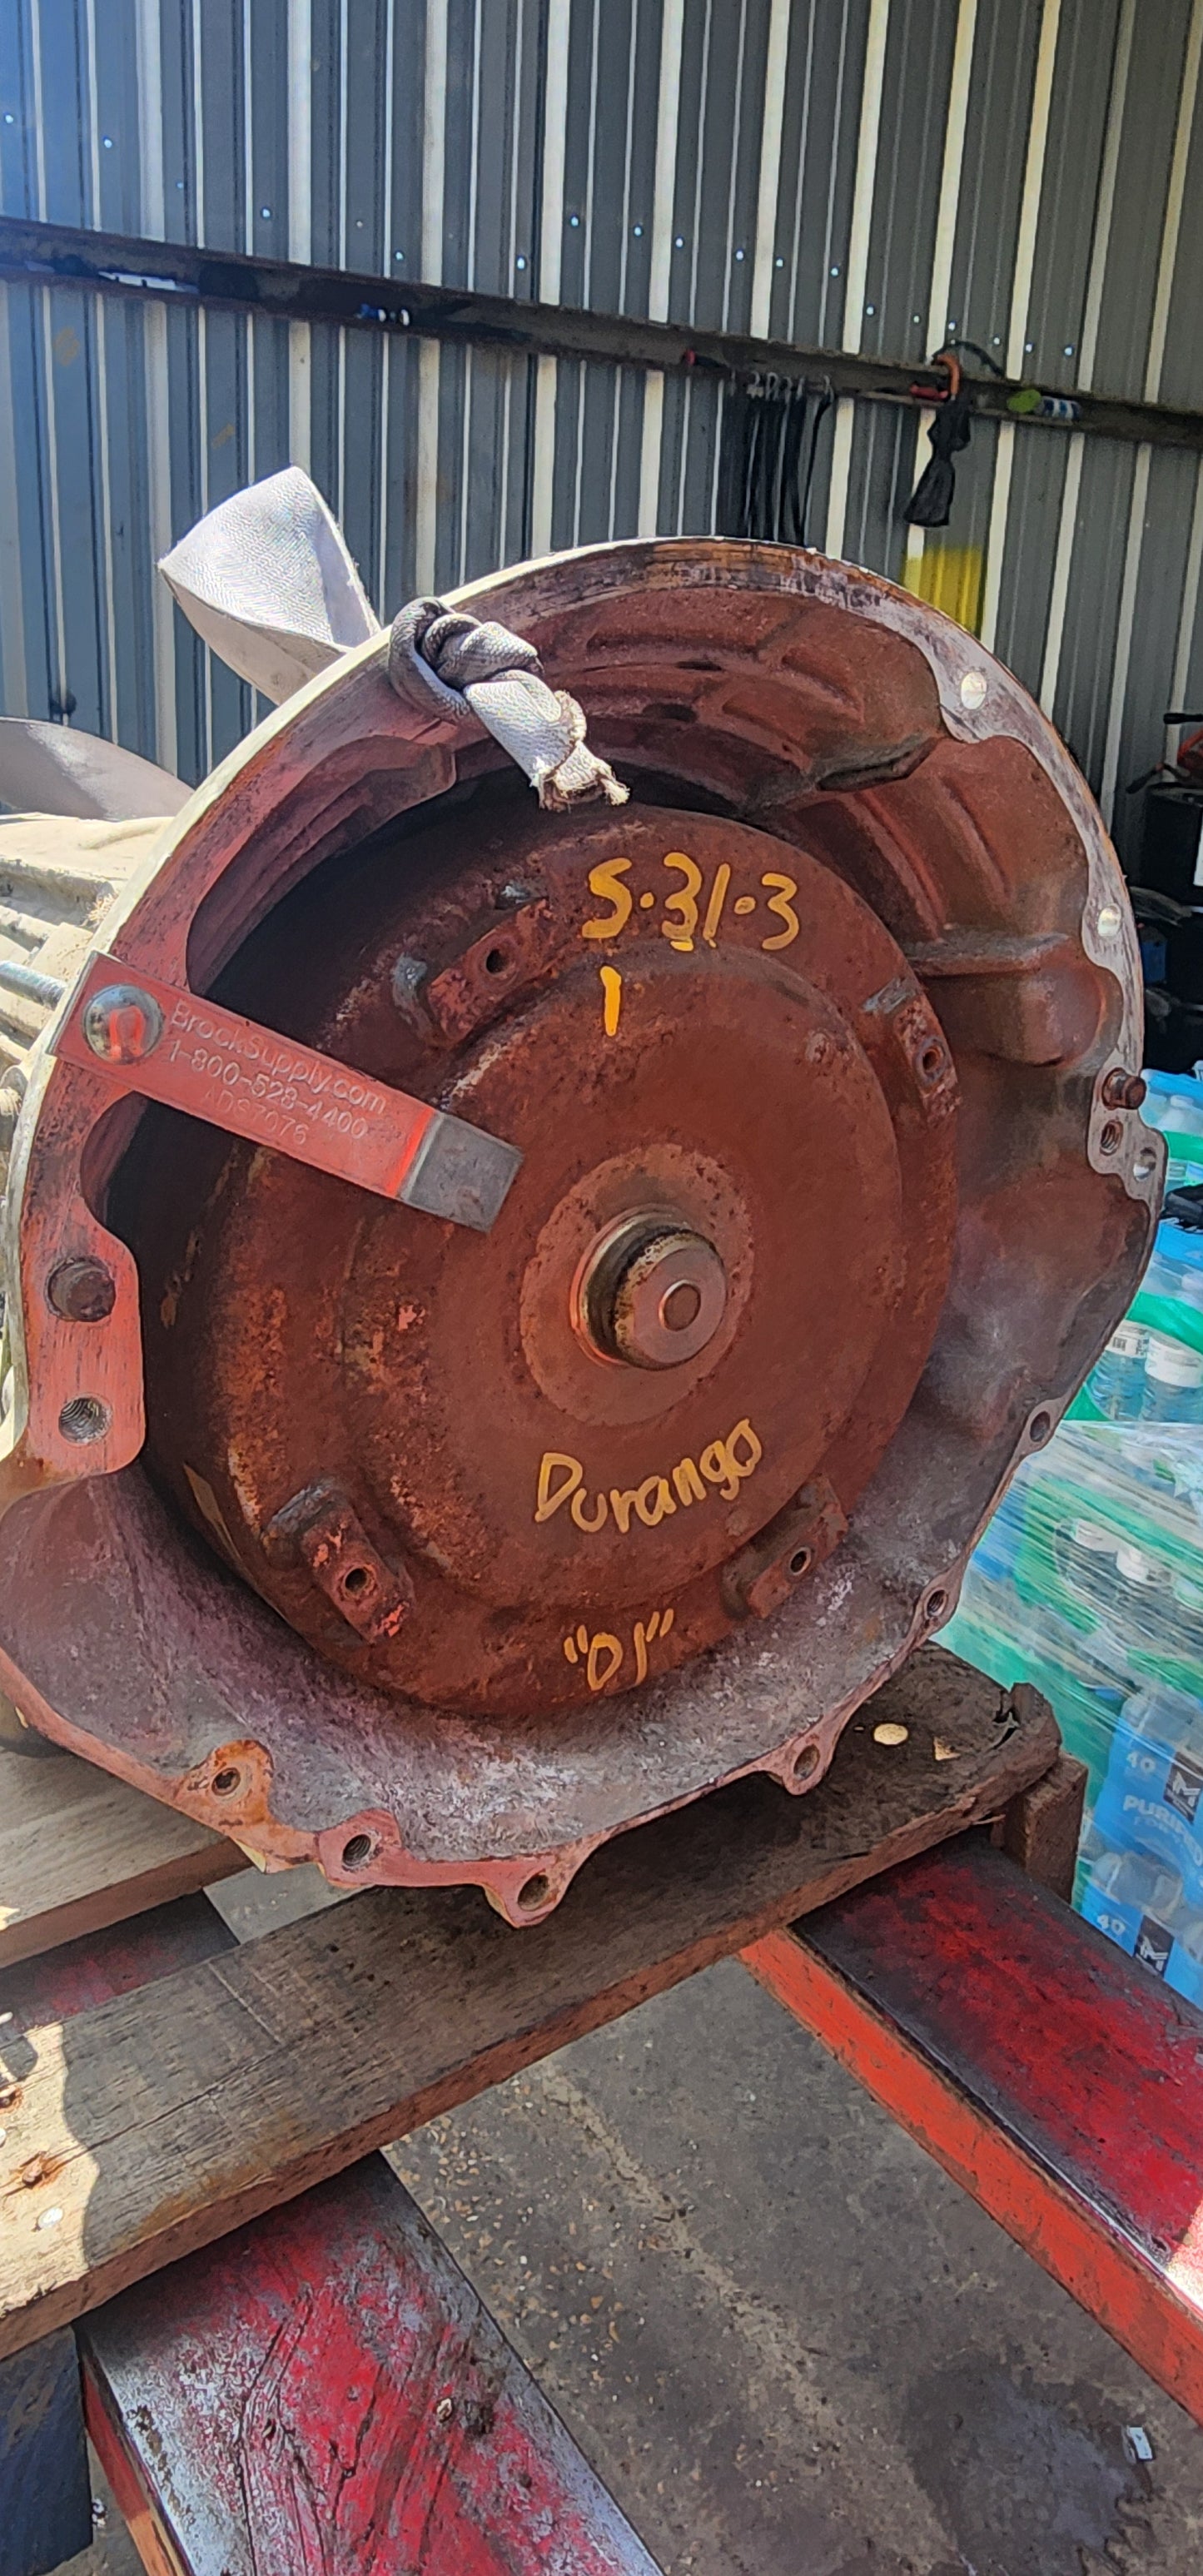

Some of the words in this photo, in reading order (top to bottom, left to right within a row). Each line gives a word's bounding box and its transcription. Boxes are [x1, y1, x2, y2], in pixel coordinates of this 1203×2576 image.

[170, 1001, 387, 1114] BrockSupply.com
[170, 1039, 369, 1139] 1-800-528-4400
[534, 1419, 762, 1533] Durango
[1126, 1751, 1156, 1774] 40
[1123, 1794, 1203, 1866] PURIFIED
[1096, 1914, 1126, 1936] 40
